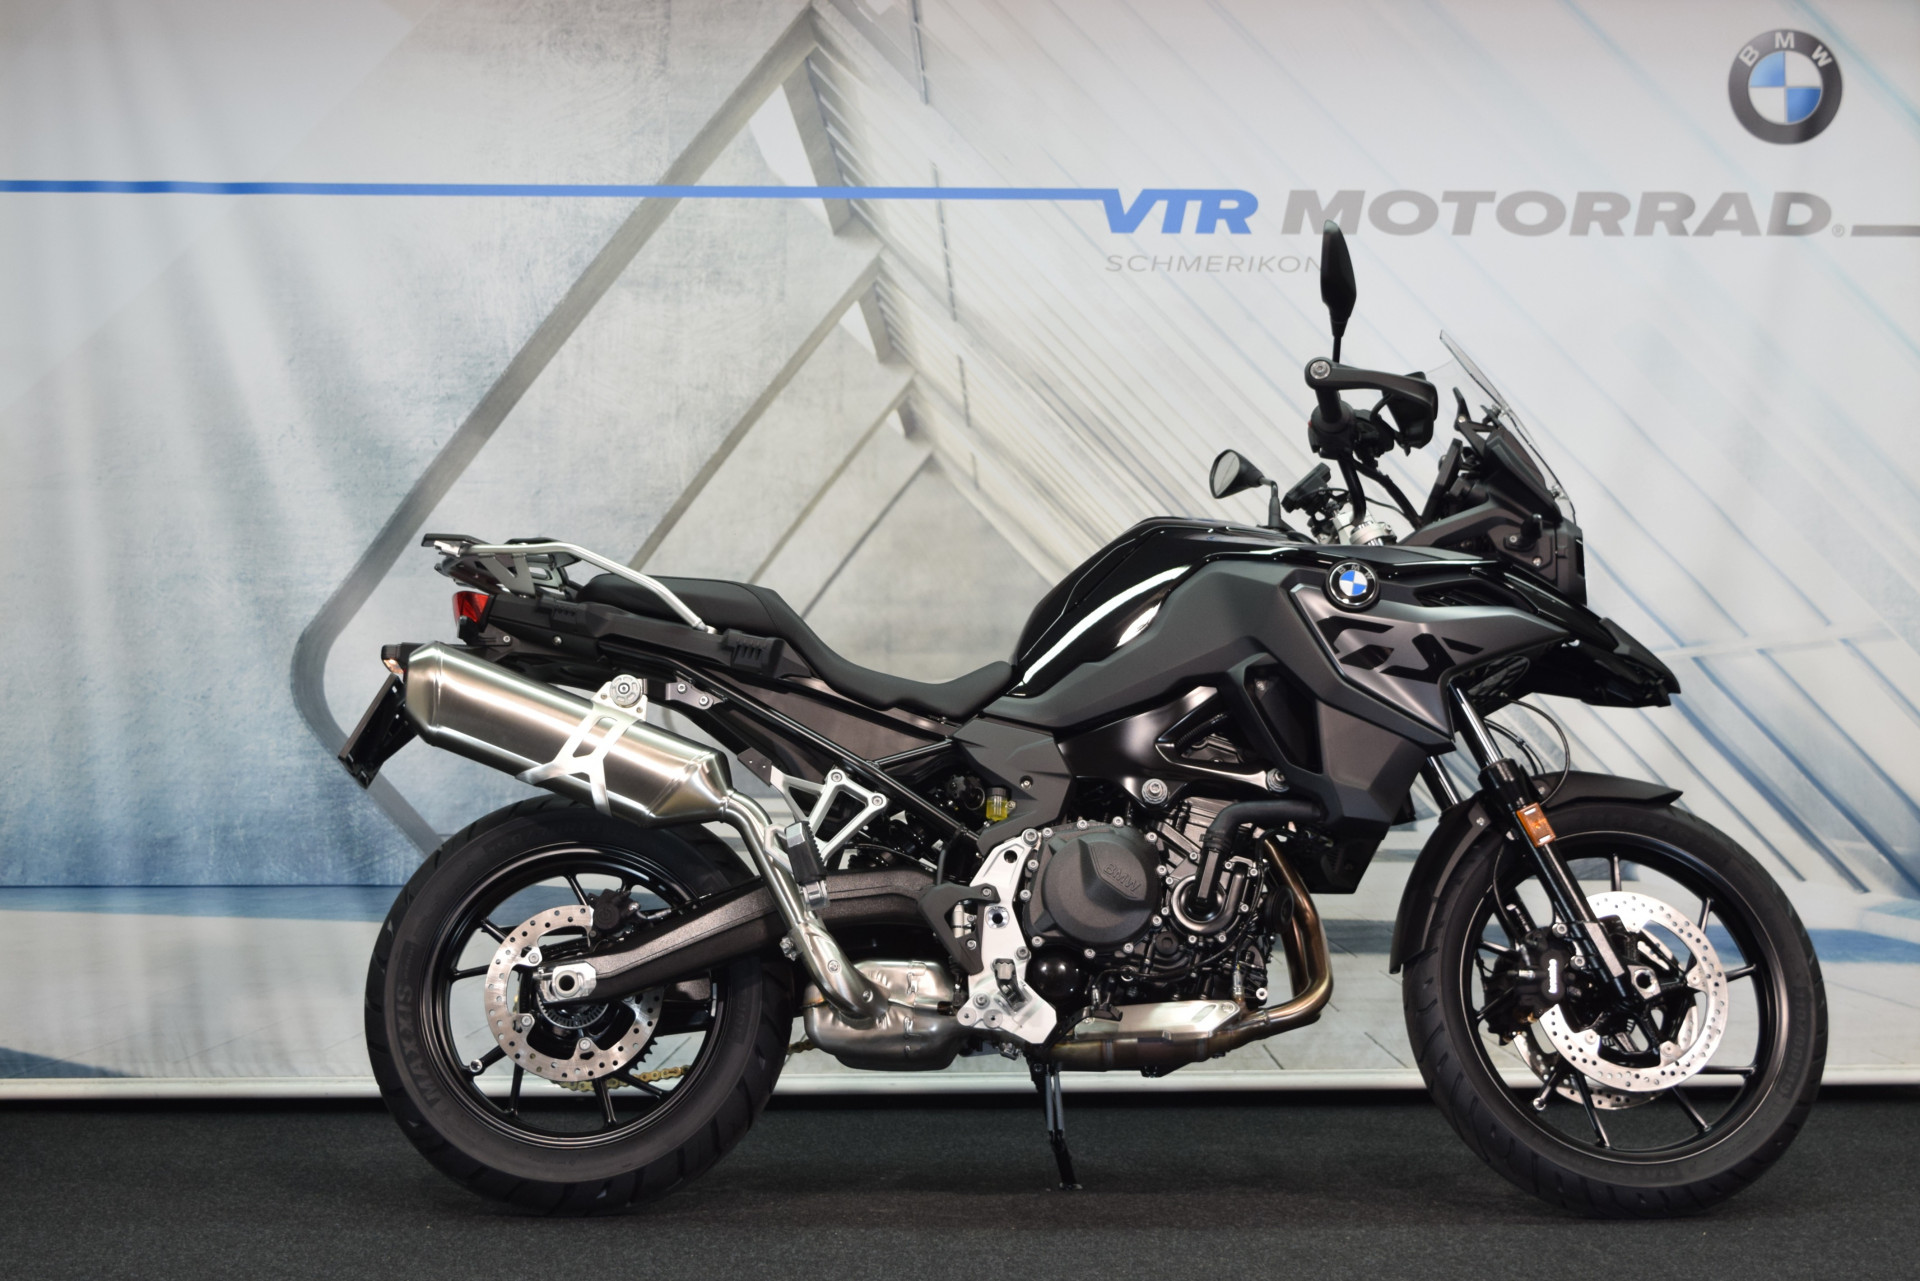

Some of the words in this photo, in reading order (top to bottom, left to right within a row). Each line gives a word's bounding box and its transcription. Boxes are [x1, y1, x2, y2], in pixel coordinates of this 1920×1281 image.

[1738, 31, 1833, 68] BMW
[1102, 188, 1259, 235] VTR
[1105, 255, 1321, 273] SCHMERIKON
[1337, 564, 1374, 580] BMW
[1103, 862, 1142, 892] BMW
[396, 983, 442, 1109] MAXXIS
